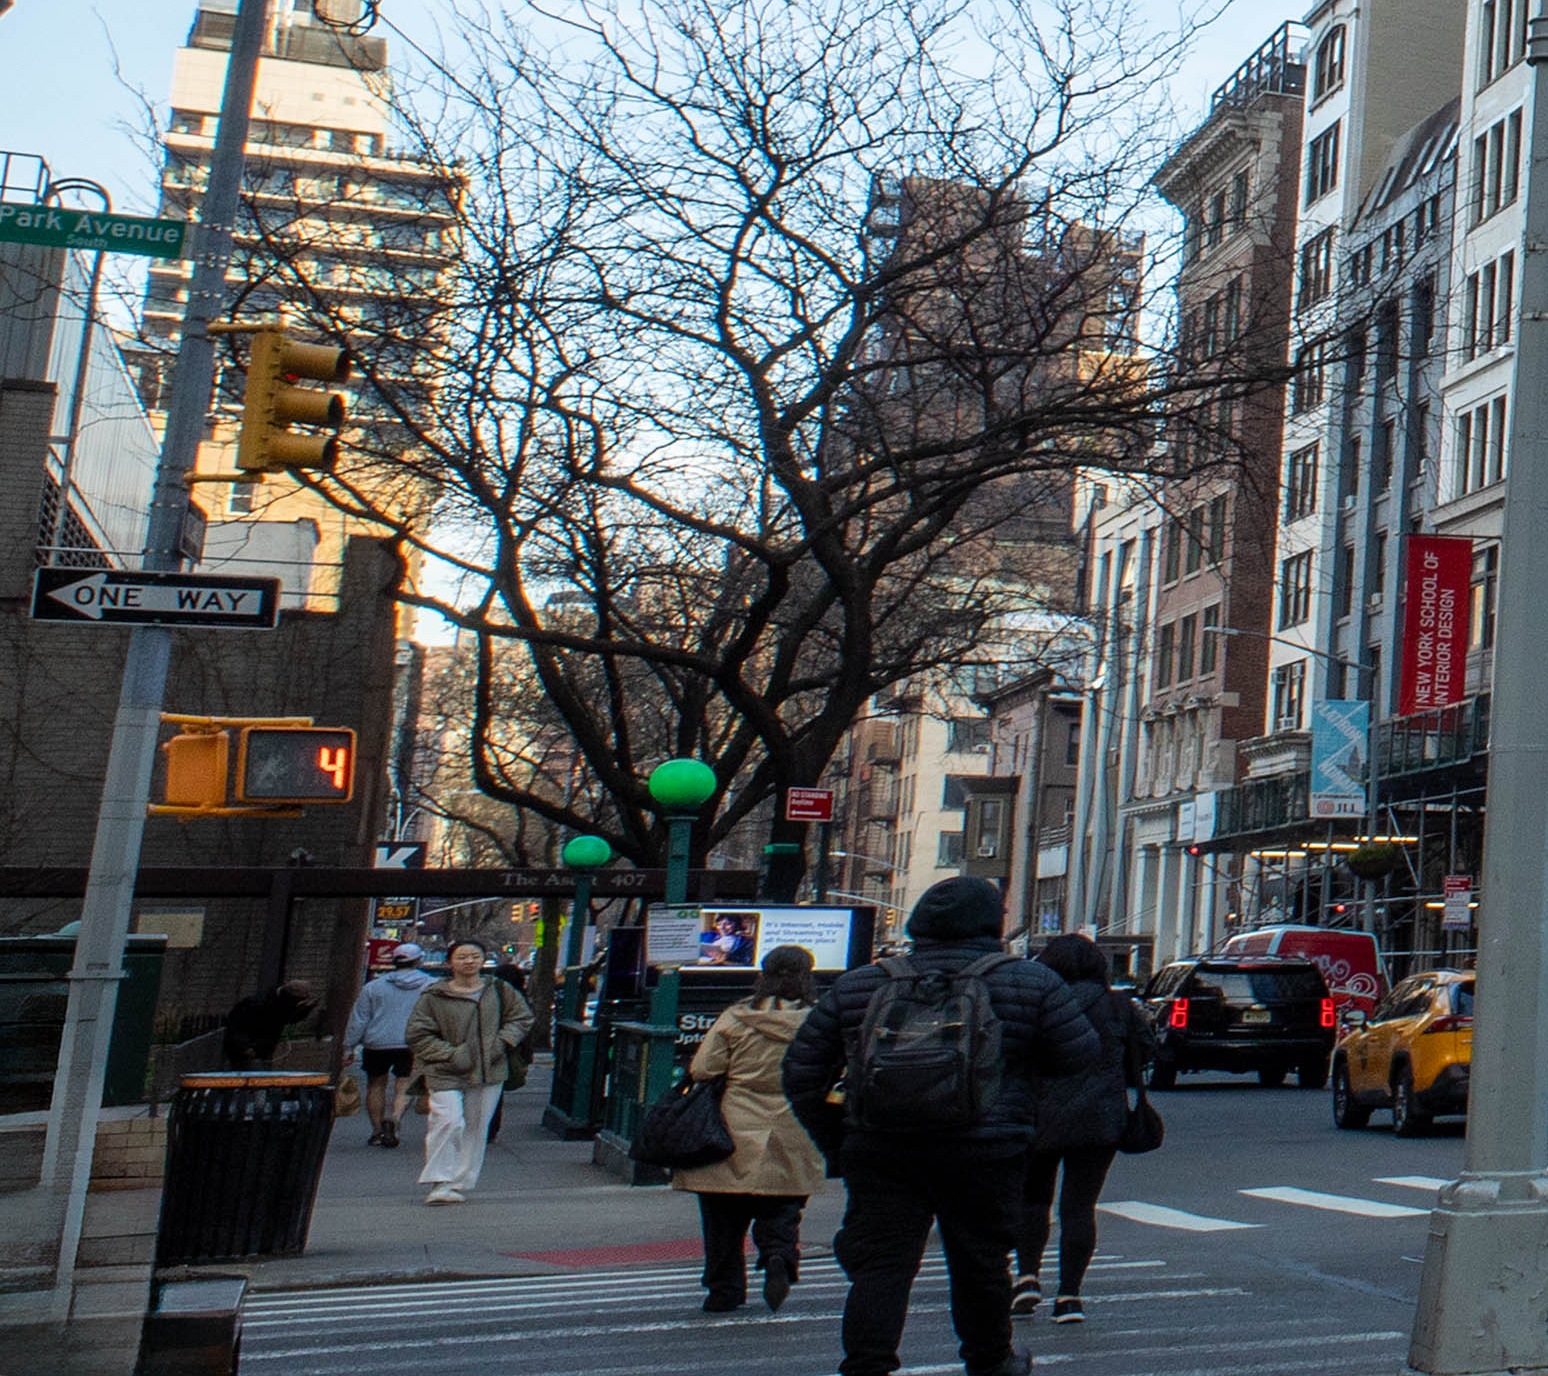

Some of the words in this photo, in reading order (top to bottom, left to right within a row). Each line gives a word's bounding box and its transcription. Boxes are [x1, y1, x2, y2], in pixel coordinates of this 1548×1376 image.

[0, 204, 62, 231] Park
[74, 214, 180, 244] Avenue
[66, 233, 108, 248] South
[1424, 551, 1440, 569] OF
[75, 585, 143, 608] ONE
[177, 589, 248, 612] WAY
[1420, 573, 1438, 627] SCHOOL
[1439, 588, 1456, 638] DESIGN
[1418, 631, 1434, 667] YORK
[1416, 671, 1432, 703] NEW
[1434, 642, 1452, 704] INTERIOR
[319, 746, 347, 789] 4
[503, 873, 538, 887] The
[543, 873, 598, 887] Asct
[611, 873, 647, 887] 407
